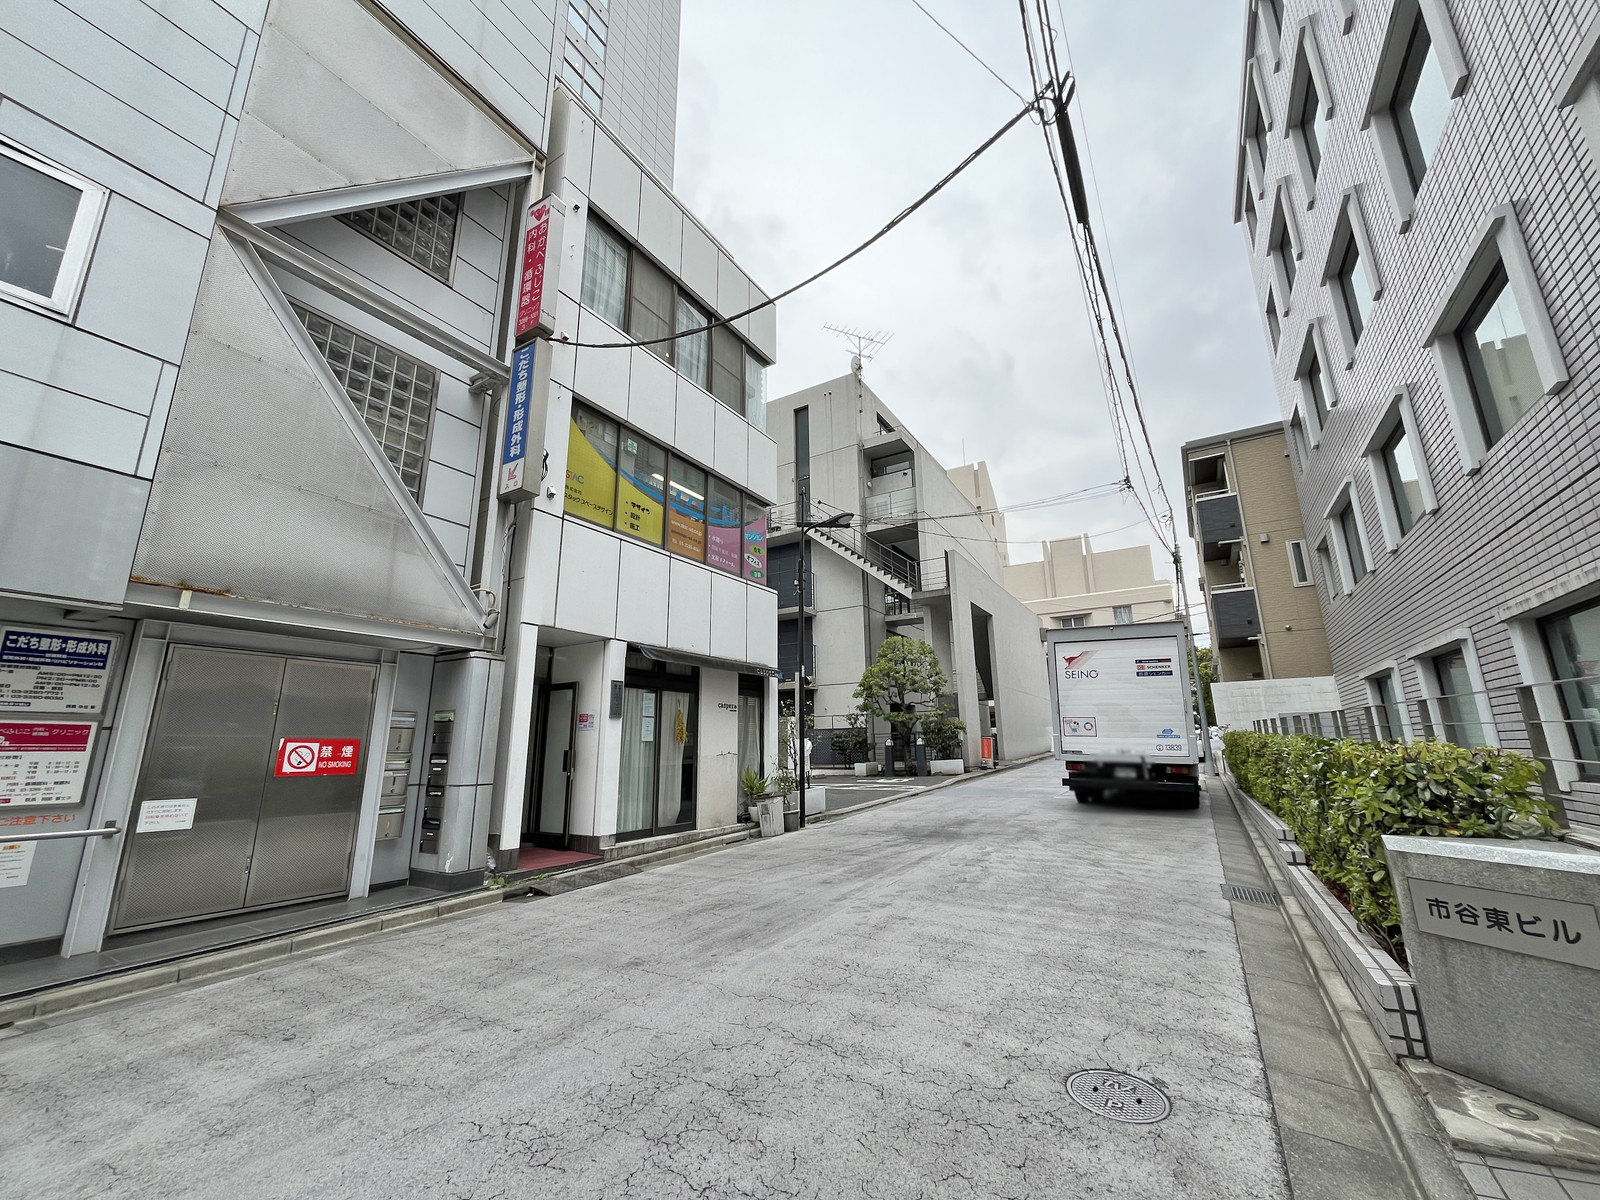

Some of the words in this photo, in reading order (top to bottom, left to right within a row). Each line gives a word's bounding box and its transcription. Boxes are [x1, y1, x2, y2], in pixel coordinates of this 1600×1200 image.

[509, 347, 531, 458] こだち整形・形成外科
[630, 501, 650, 515] デザイン
[6, 635, 109, 655] こだち整形・形成外科
[52, 728, 89, 736] クリニック
[320, 745, 354, 758] 禁煙
[318, 761, 327, 769] NO
[327, 760, 352, 769] SMOKING
[1425, 897, 1582, 945] 市谷東ビル
